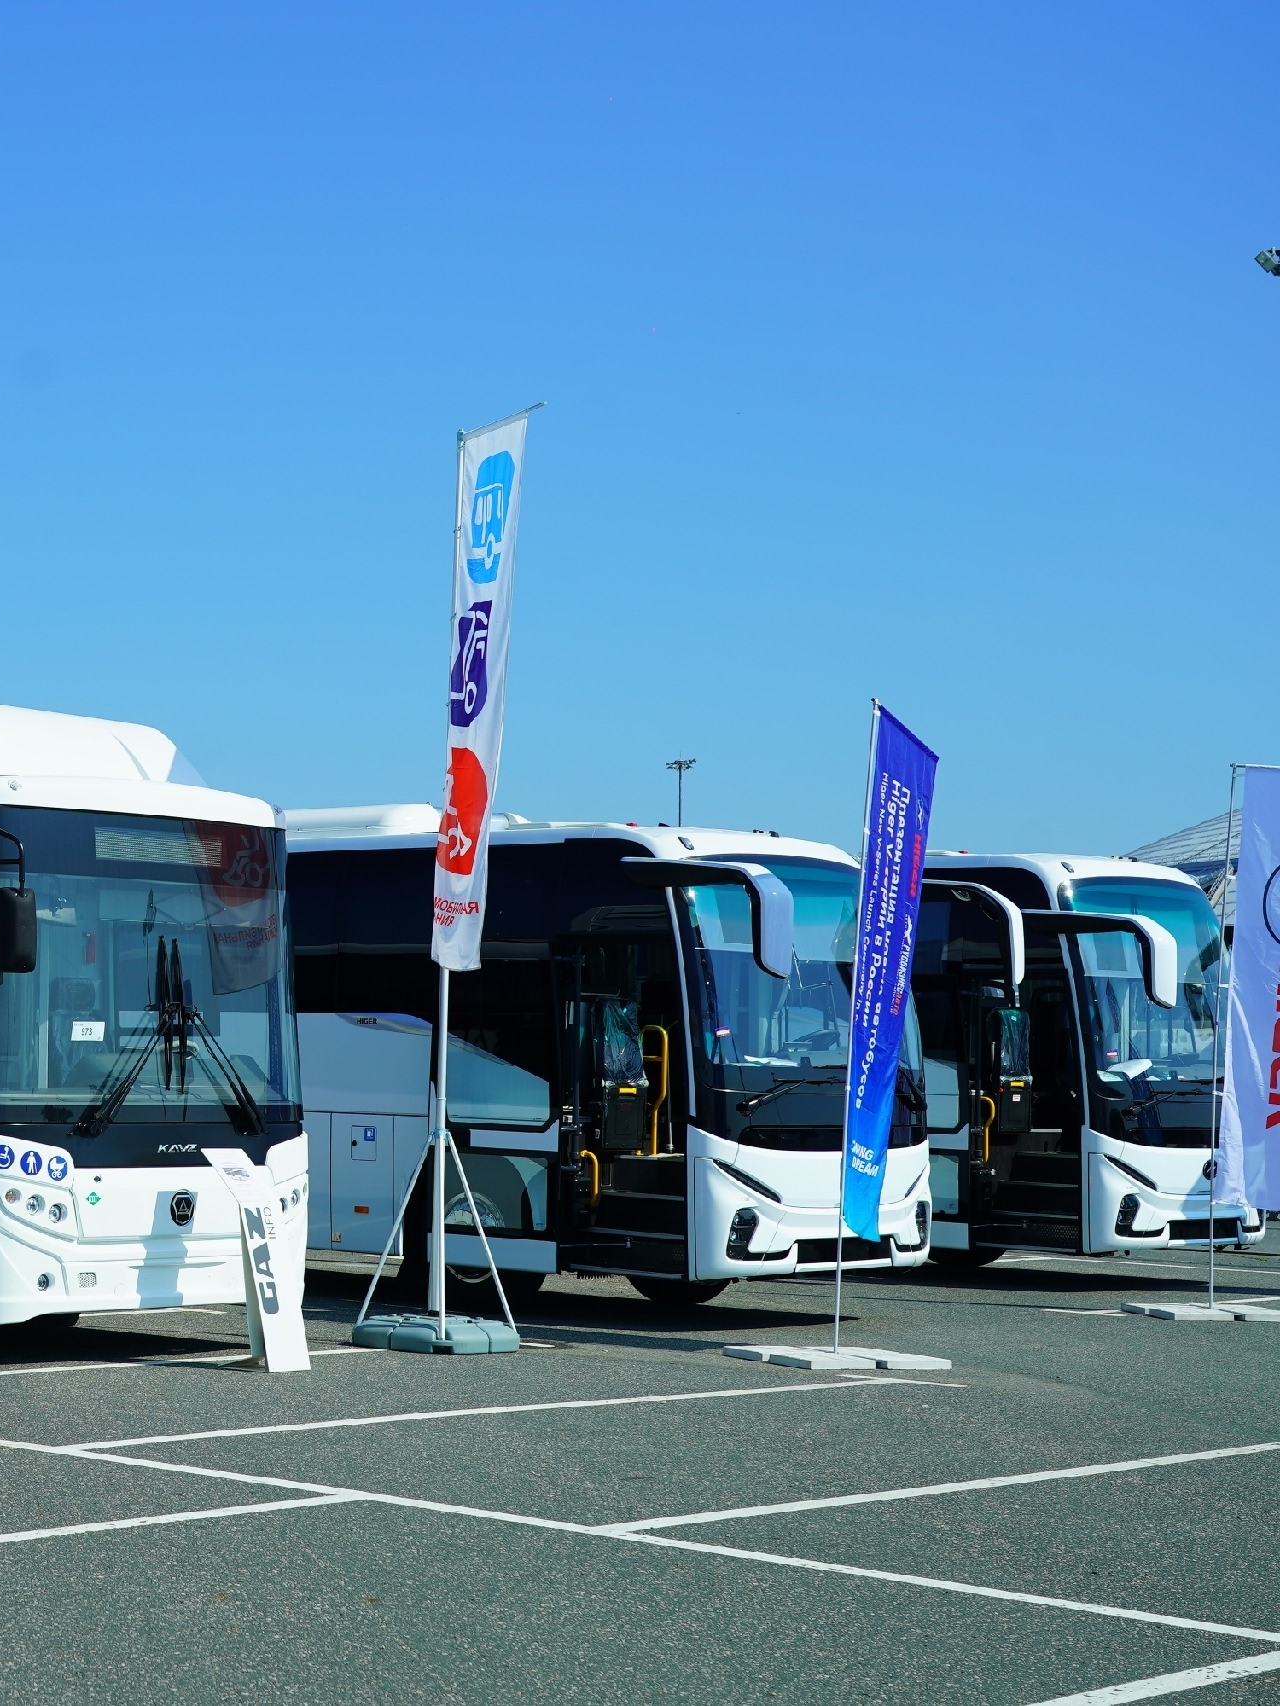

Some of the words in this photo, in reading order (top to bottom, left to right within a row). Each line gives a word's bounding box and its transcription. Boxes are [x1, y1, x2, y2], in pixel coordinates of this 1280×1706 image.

[879, 772, 889, 807] Higer
[877, 808, 886, 835] New
[886, 779, 901, 838] Higer
[864, 889, 878, 933] Launch
[863, 952, 882, 1028] России
[356, 1017, 378, 1025] HIGER
[856, 1001, 882, 1110] автобусов
[157, 1143, 198, 1154] KAVZ
[851, 1156, 880, 1177] DREAM
[263, 1206, 277, 1240] INFO
[244, 1207, 280, 1315] GAZ
